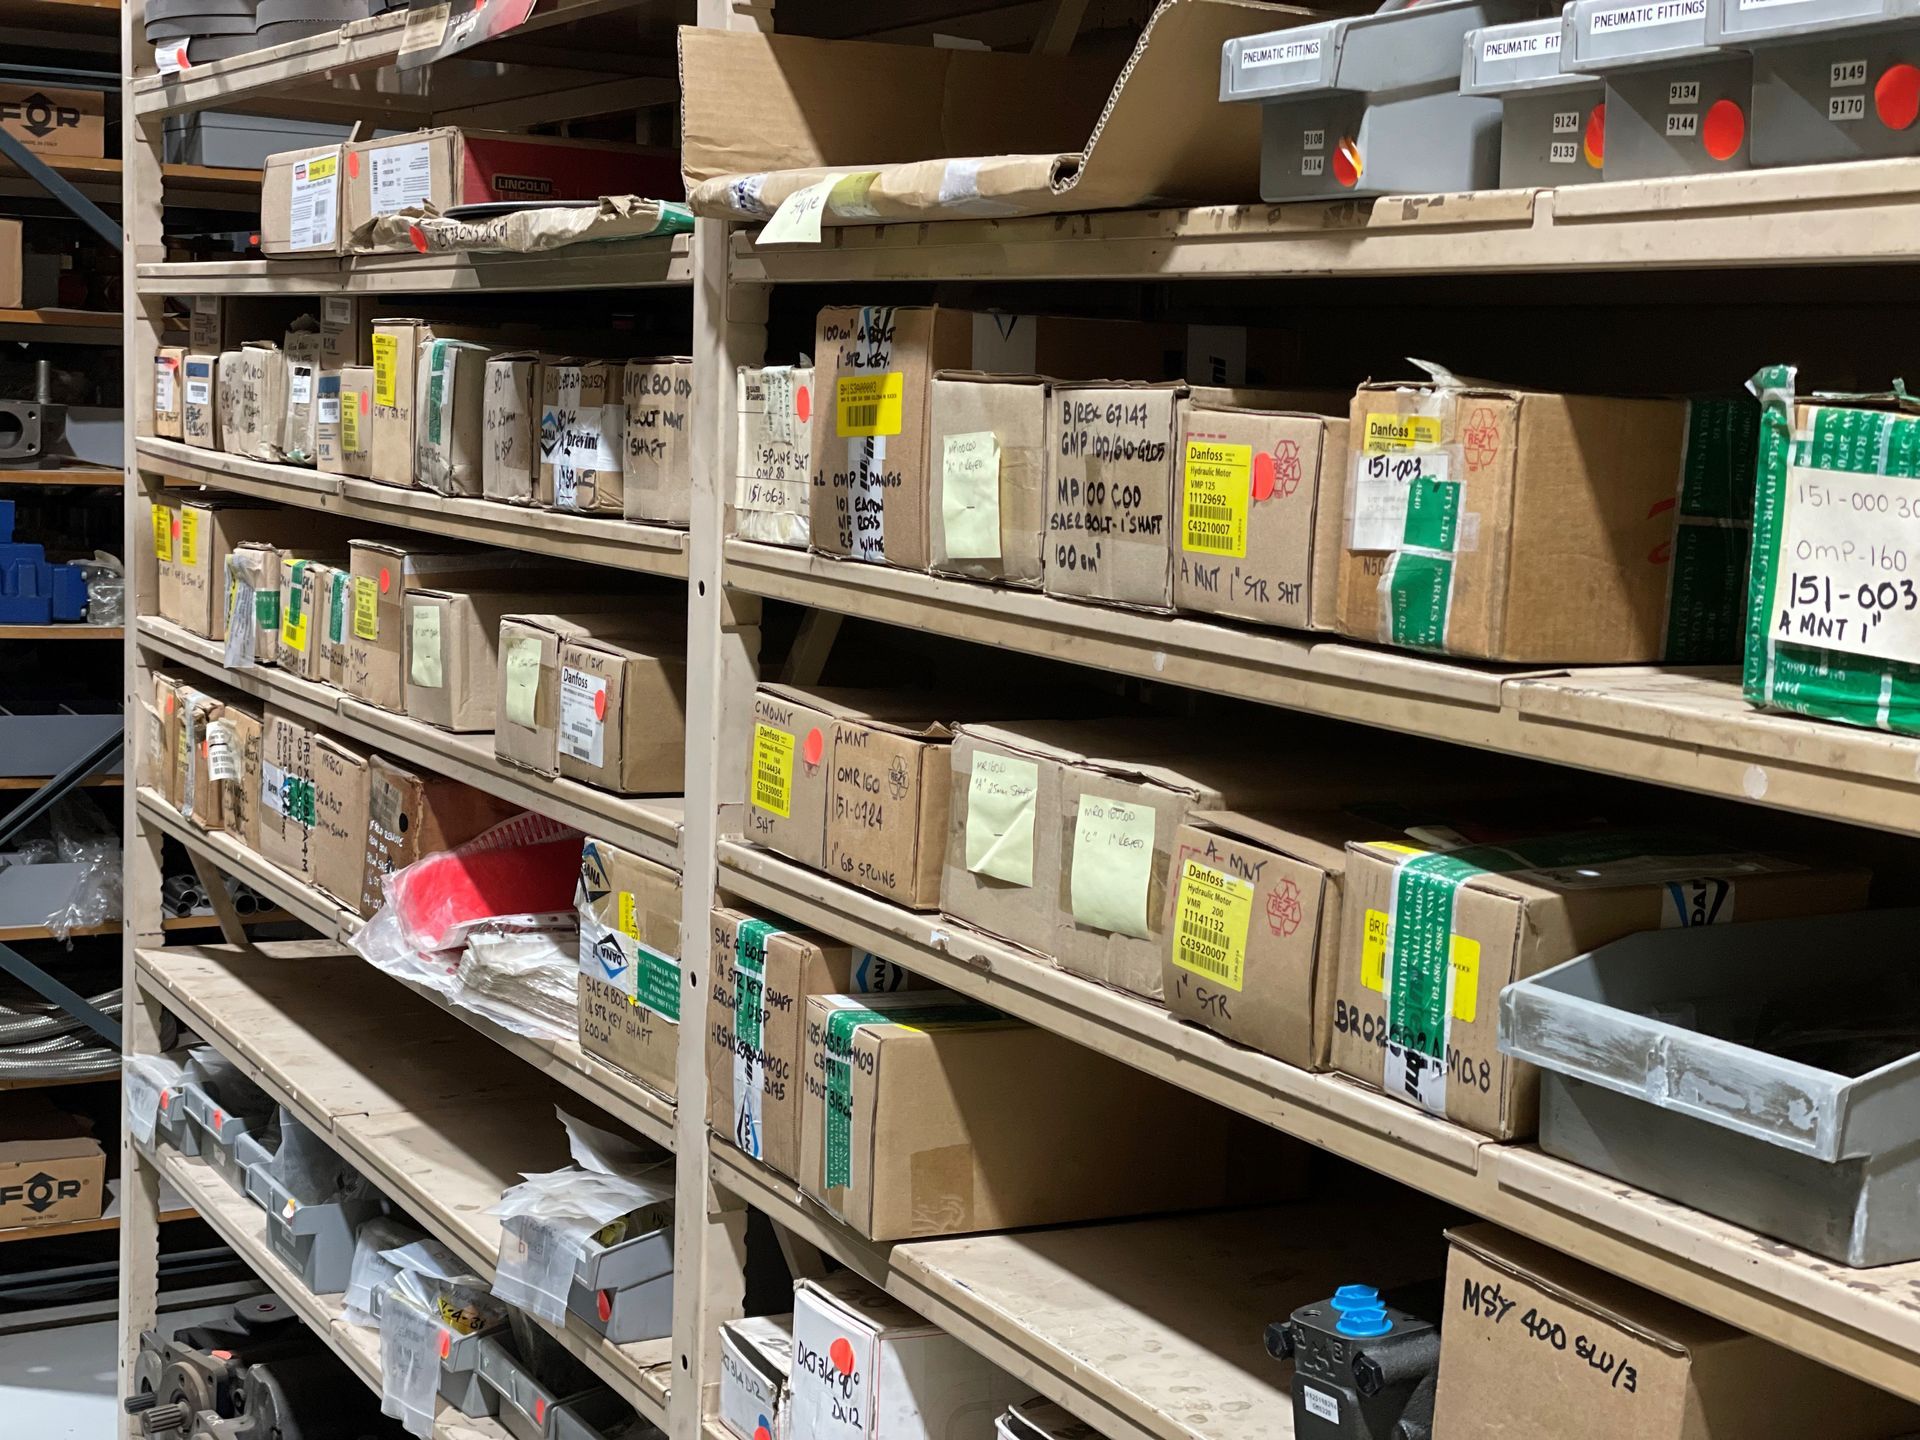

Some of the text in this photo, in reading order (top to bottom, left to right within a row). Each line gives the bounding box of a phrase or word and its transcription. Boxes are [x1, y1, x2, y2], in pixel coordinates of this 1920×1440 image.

[1594, 0, 1705, 28] PNEUMATIC FITTINGS
[1243, 42, 1319, 64] PNEUMATIC FITTINGS
[1485, 38, 1537, 56] PNEUMATIC
[1832, 65, 1865, 81] 9149
[1671, 85, 1697, 99] 9134
[1831, 99, 1863, 115] 9170
[1554, 115, 1578, 129] 9124
[1668, 117, 1695, 131] 9144
[1304, 132, 1323, 146] 9108
[1552, 146, 1576, 159] 9133
[1303, 159, 1322, 172] 9114
[498, 177, 550, 193] LINCOLN
[857, 326, 897, 344] 4 BOLT
[845, 354, 866, 369] STR
[1105, 403, 1148, 429] 67147
[1371, 422, 1409, 438] Danfoss
[1061, 431, 1088, 459] GMP
[1190, 446, 1224, 462] Danfoss
[762, 448, 790, 466] SPLINE
[1368, 454, 1422, 481] 151-003
[833, 471, 857, 489] OMP
[1190, 465, 1232, 478] Hydraulic Motor
[1111, 482, 1142, 510] COD
[1190, 479, 1216, 491] VMP 125
[855, 496, 884, 514] EATON
[1189, 492, 1227, 506] 11129692
[857, 514, 880, 531] ROSS
[1187, 519, 1231, 535] C43210007
[1440, 515, 1450, 543] LTD
[1180, 556, 1189, 584] A
[1194, 562, 1221, 593] MNT
[1244, 575, 1270, 603] STR
[1277, 581, 1304, 605] SHT
[1430, 567, 1443, 622] PARKES
[1778, 609, 1792, 636] A
[1799, 611, 1849, 642] MNT
[563, 668, 589, 690] Danfoss
[759, 726, 781, 742] Danfoss
[837, 766, 861, 788] OMR
[756, 816, 776, 834] SHT
[1204, 837, 1268, 883] A MNT
[1188, 864, 1225, 888] Danfoss
[1187, 883, 1232, 907] Hydraulic Motor
[1186, 896, 1225, 918] VMR 200
[1436, 891, 1448, 922] FAX:
[1184, 908, 1225, 933] 11141132
[1422, 889, 1436, 976] PARKES NSW
[1434, 925, 1445, 953] 5885
[600, 945, 623, 968] DANA
[714, 926, 769, 966] SAE 4 BOLT
[1180, 935, 1227, 962] C43920007
[1398, 908, 1413, 988] HYDRAULIC
[1433, 955, 1443, 982] 6862
[586, 977, 602, 1001] SAE
[603, 984, 611, 1004] 4
[610, 988, 630, 1017] BOLT
[727, 967, 794, 1013] STR KEY SHAFT
[1431, 982, 1441, 1000] 02
[1195, 986, 1233, 1020] STR
[594, 1002, 607, 1023] STR
[608, 1012, 623, 1031] KEY
[625, 1020, 654, 1047] SHAFT
[747, 1002, 771, 1029] DISP
[584, 1019, 600, 1041] 200
[763, 1076, 786, 1101] 3175
[809, 1076, 828, 1101] BOLT
[1520, 1308, 1566, 1351] 400
[818, 1356, 835, 1390] 3/4
